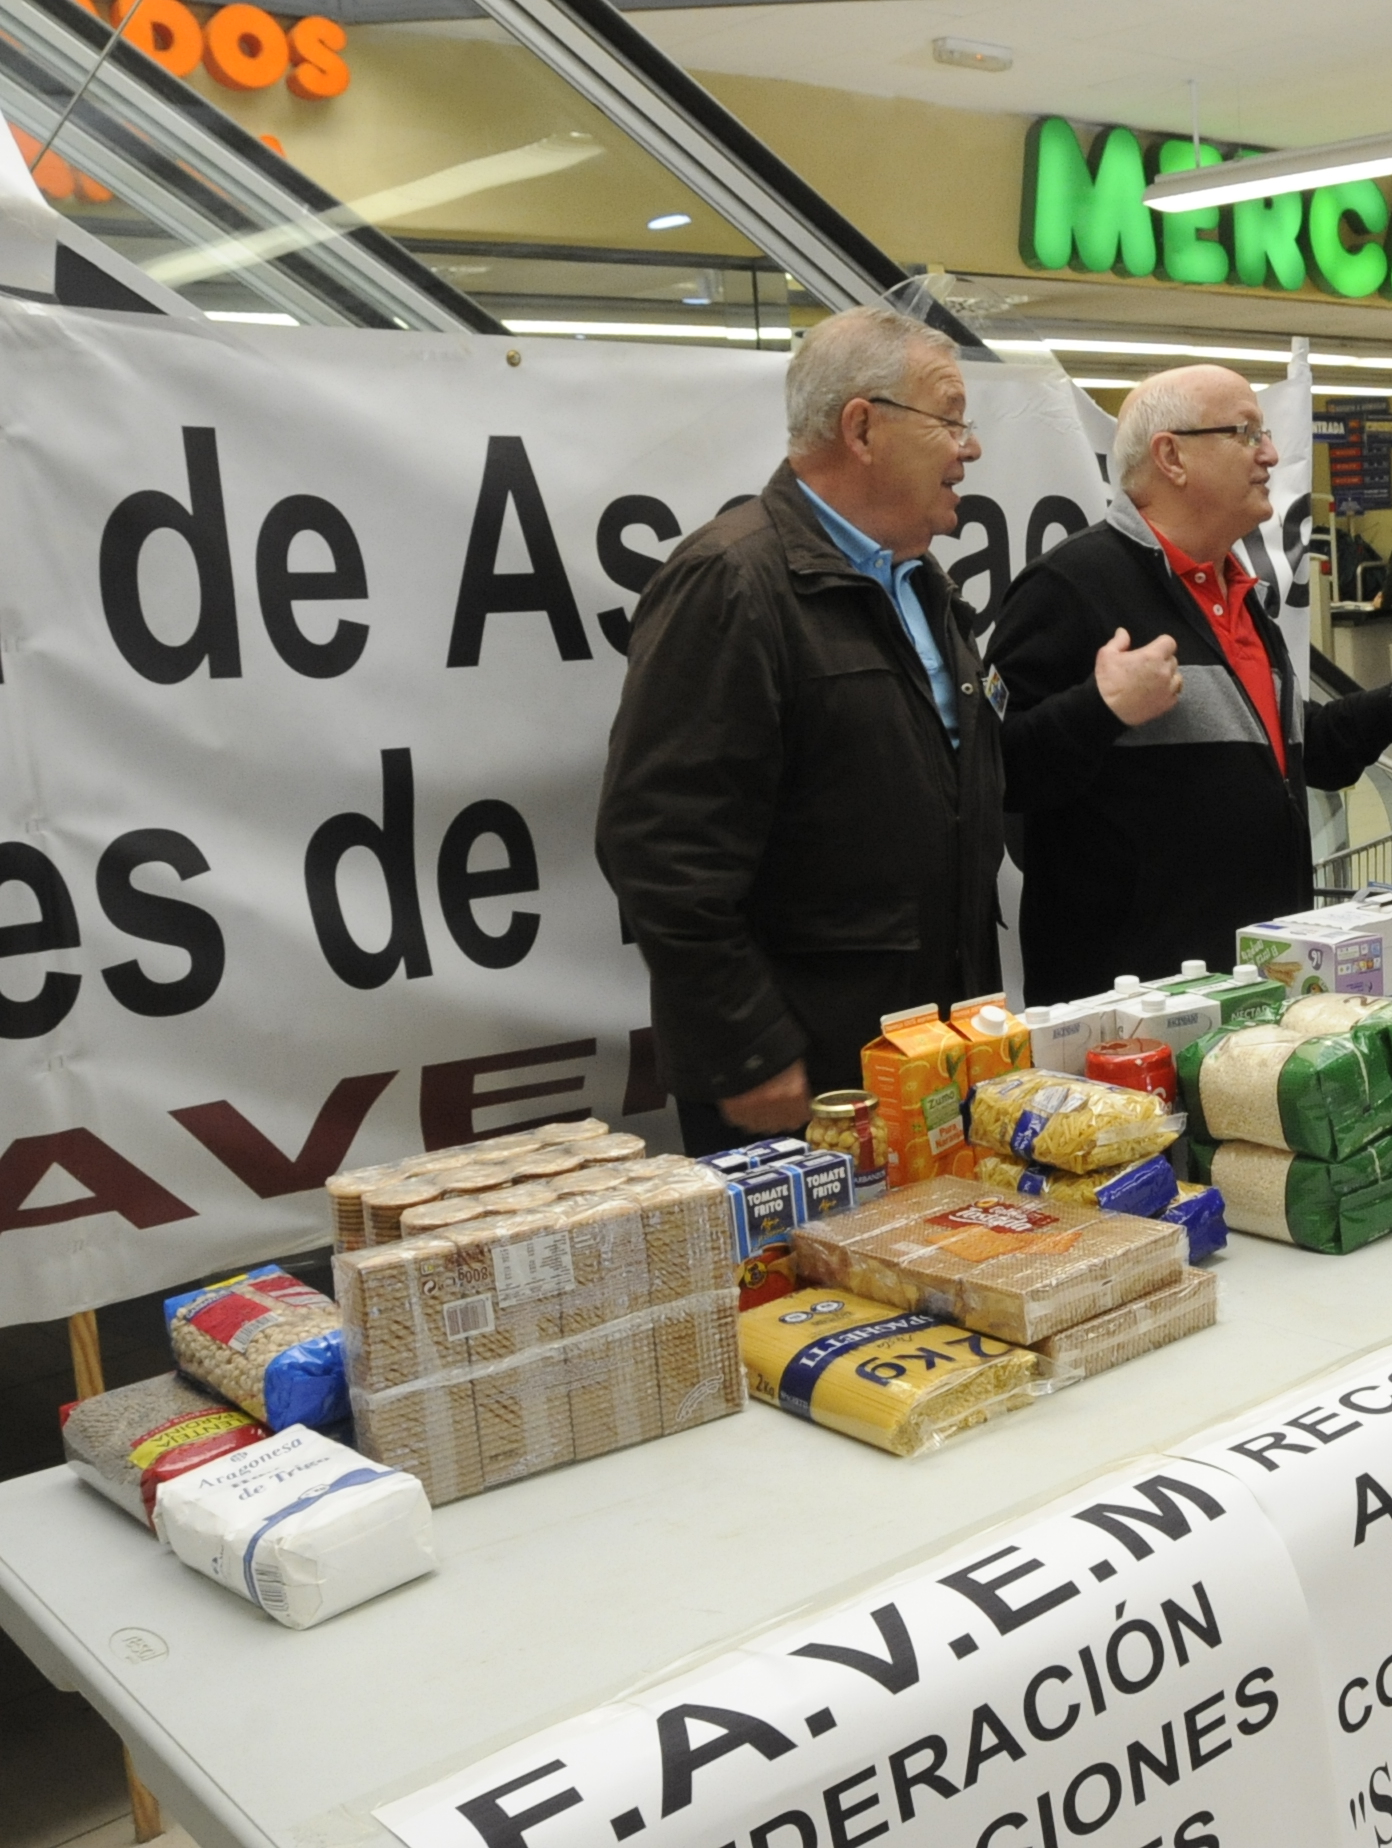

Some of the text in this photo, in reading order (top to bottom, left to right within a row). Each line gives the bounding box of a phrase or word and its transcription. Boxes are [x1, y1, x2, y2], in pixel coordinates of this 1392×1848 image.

[99, 426, 370, 685] de
[304, 747, 541, 990] de
[806, 1166, 846, 1188] TOMATE
[746, 1184, 790, 1207] TOMATE
[812, 1181, 842, 1200] FRITO
[753, 1199, 784, 1218] FRITO
[198, 1437, 304, 1490] Aragonesa
[237, 1483, 266, 1501] de
